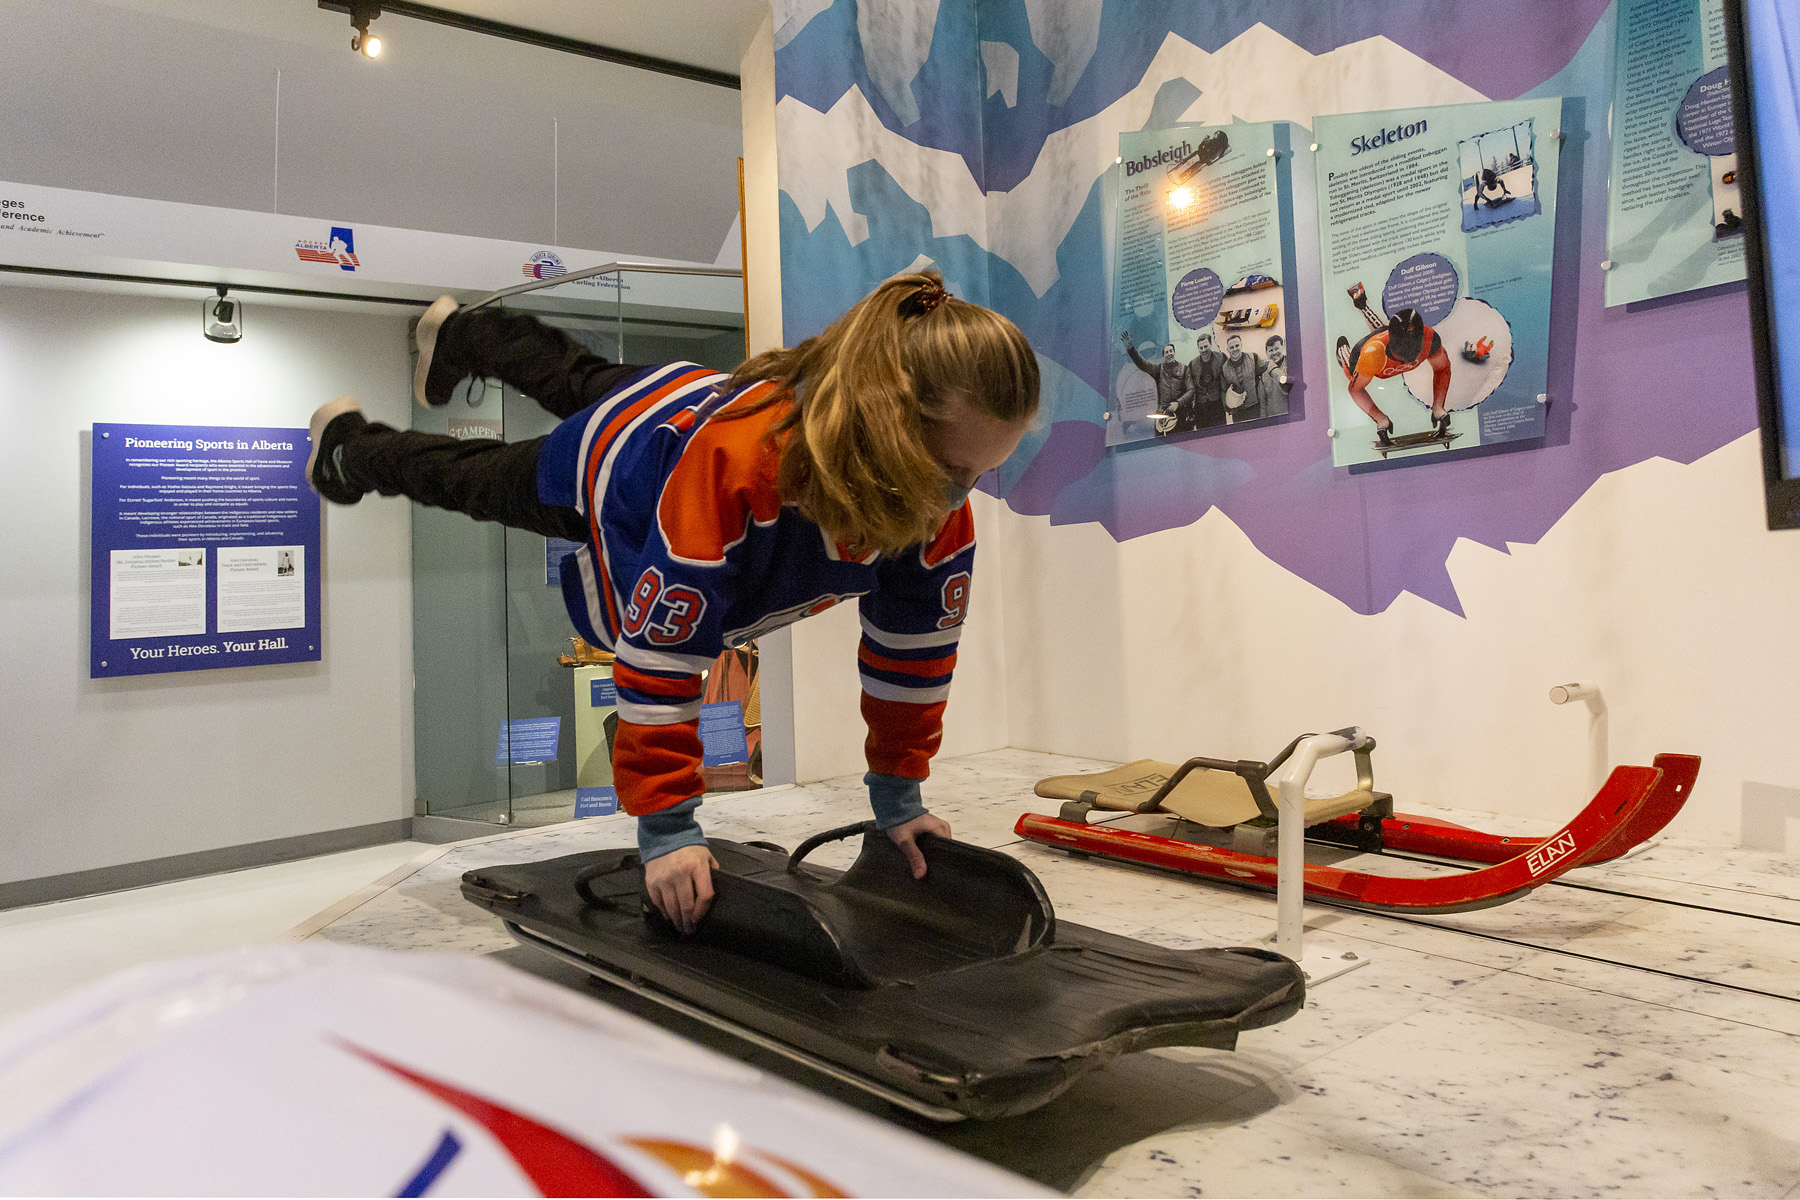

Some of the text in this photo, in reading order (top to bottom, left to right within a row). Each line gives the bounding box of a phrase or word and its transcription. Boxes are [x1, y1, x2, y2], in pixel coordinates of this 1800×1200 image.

[1700, 82, 1723, 93] Doug
[1350, 119, 1428, 157] Skeleton
[1125, 140, 1192, 177] Bobsleigh
[1328, 172, 1349, 182] Possibly
[1359, 162, 1374, 172] oldest
[1390, 153, 1407, 162] sliding
[1407, 148, 1426, 157] events,
[1328, 178, 1349, 188] skeleton
[1359, 165, 1386, 179] introduced
[1399, 154, 1421, 166] modified
[1423, 147, 1448, 158] toboggan
[1329, 187, 1359, 200] Tobogganing
[1360, 178, 1385, 193] (skeleton)
[1400, 169, 1417, 178] medal
[1417, 164, 1432, 174] sport
[1351, 179, 1369, 187] Moritz,
[1369, 168, 1398, 182] Switzerland
[1405, 162, 1419, 170] 1884.
[1125, 182, 1149, 196] The Thrill
[1130, 192, 1139, 200] the
[1330, 206, 1338, 214] not
[1339, 202, 1355, 211] return
[1365, 193, 1381, 203] medal
[1382, 189, 1396, 199] sport
[1396, 185, 1409, 193] until
[1423, 174, 1449, 185] featuring
[1347, 193, 1363, 202] Moritz
[1364, 186, 1387, 197] Olympics
[0, 199, 25, 209] ges
[1334, 206, 1363, 219] modernized
[1363, 202, 1375, 210] sled,
[1375, 195, 1396, 206] adapted
[1414, 186, 1431, 194] newer
[0, 209, 45, 222] erence
[1330, 209, 1377, 226] refrigerated tracks.
[18, 225, 53, 234] Academic
[1400, 262, 1437, 276] Duff Gibson
[597, 281, 631, 290] Federaion
[125, 437, 293, 451] Pioneering Sports in Alberta
[621, 566, 708, 646] 93
[936, 571, 970, 630] 9
[130, 637, 289, 660] Your Heroes. Your Hall.
[1527, 833, 1576, 874] ELAN
